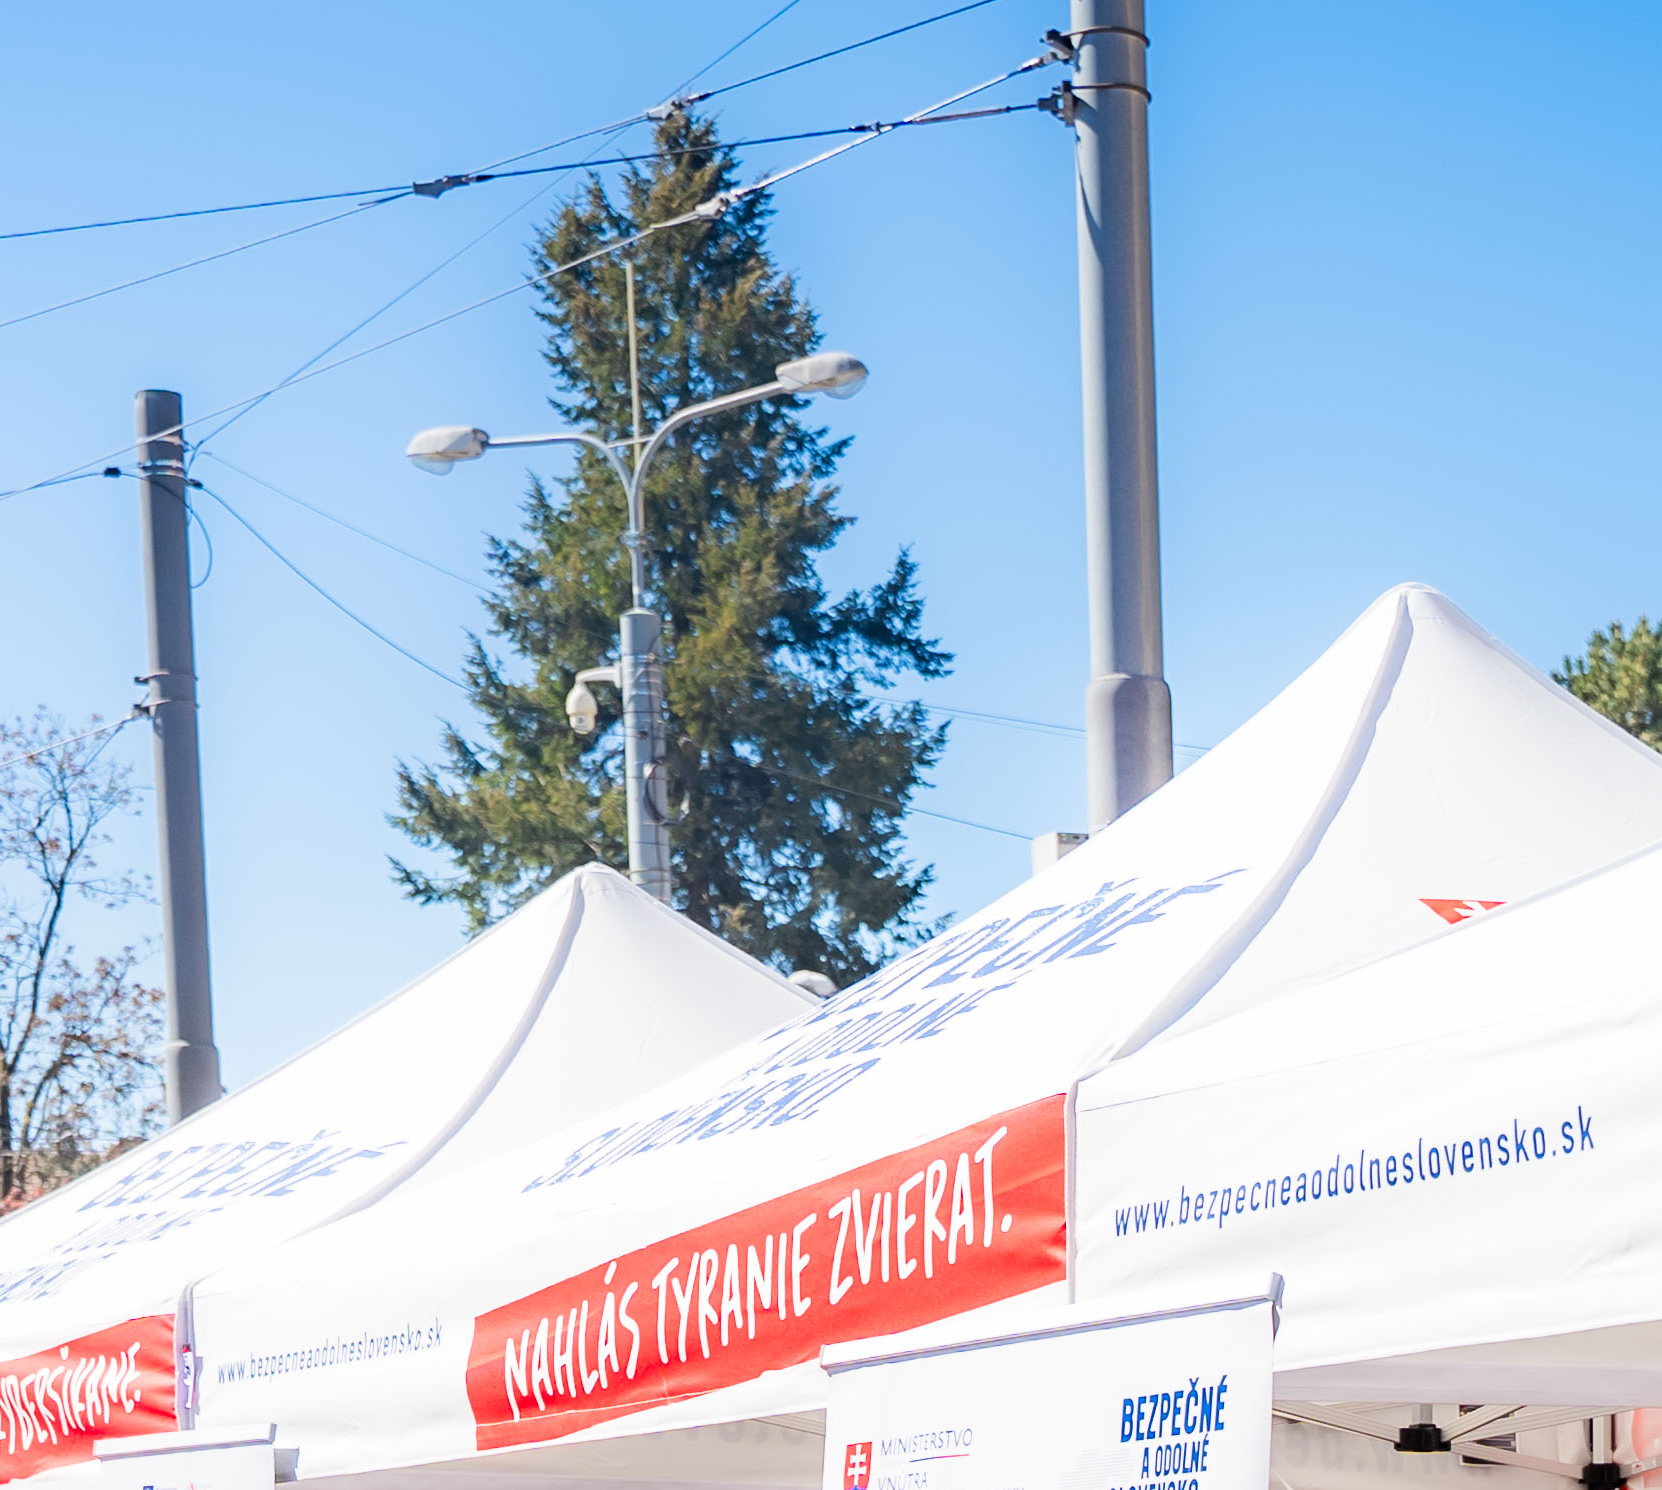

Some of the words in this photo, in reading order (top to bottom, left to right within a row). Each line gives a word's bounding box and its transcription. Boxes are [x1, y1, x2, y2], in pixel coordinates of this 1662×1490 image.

[1113, 1104, 1595, 1239] www.bezpecneaodolneslovensko.sk
[504, 1259, 639, 1424] NAHLÁS
[652, 1211, 818, 1366] TYRANIE
[827, 1125, 1014, 1307] ZVIERAT.
[217, 1321, 443, 1386] www.bezpecneaodolneslovensko.sk
[880, 1428, 973, 1456] MINISTERSTVO
[1119, 1374, 1230, 1443] BEZPEČNÉ
[1140, 1451, 1150, 1478] A
[1154, 1433, 1211, 1477] ODOLNÉ
